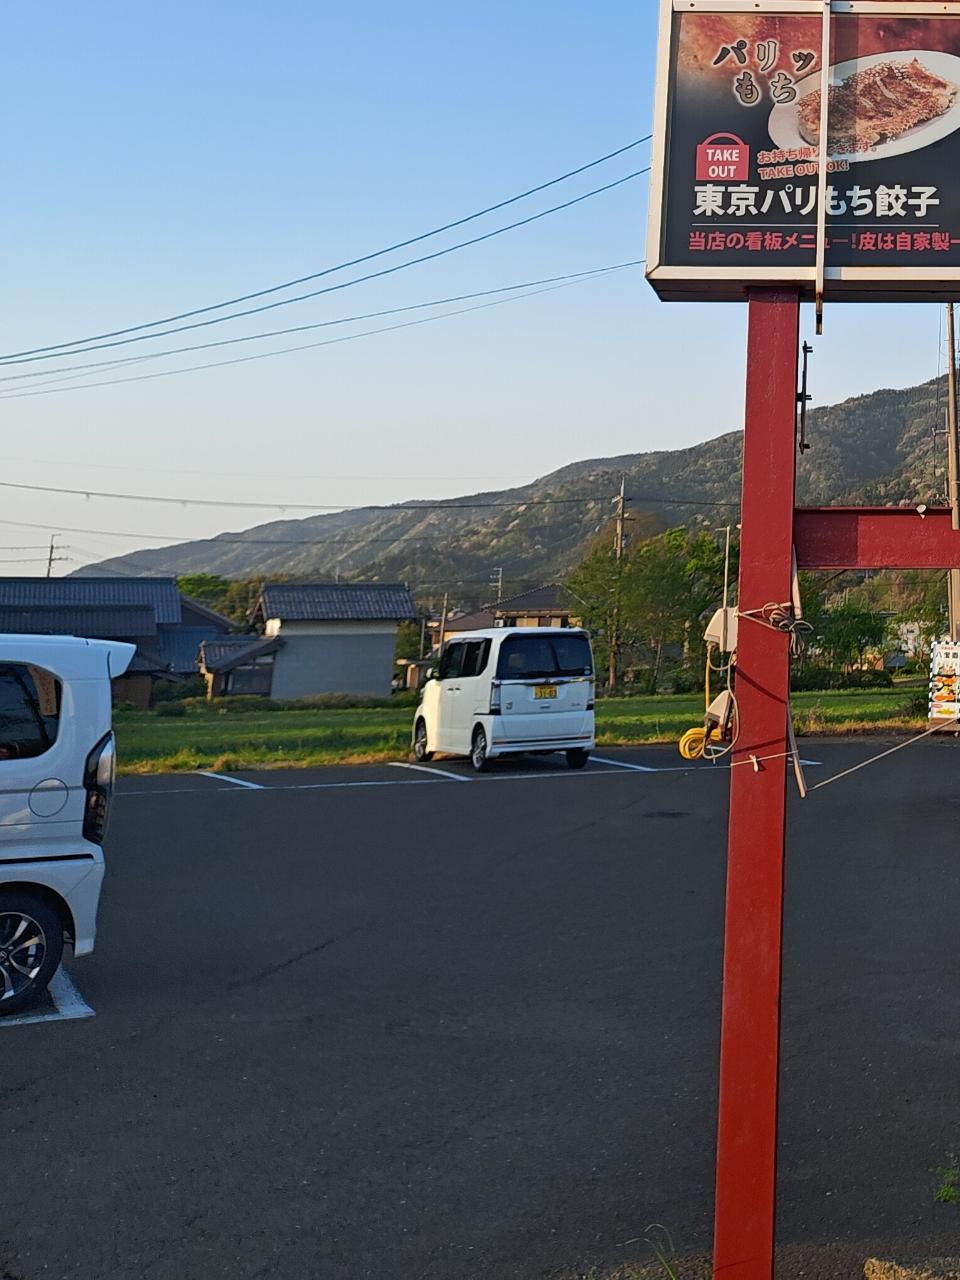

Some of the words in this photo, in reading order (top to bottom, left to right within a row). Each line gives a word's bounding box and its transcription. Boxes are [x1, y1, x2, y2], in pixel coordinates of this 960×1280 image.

[713, 39, 816, 72] パリッ
[734, 71, 798, 105] もち
[706, 149, 740, 162] TAKE
[708, 165, 737, 178] OUT
[758, 166, 794, 180] TAKE
[692, 183, 940, 218] 東京パリもち餃子
